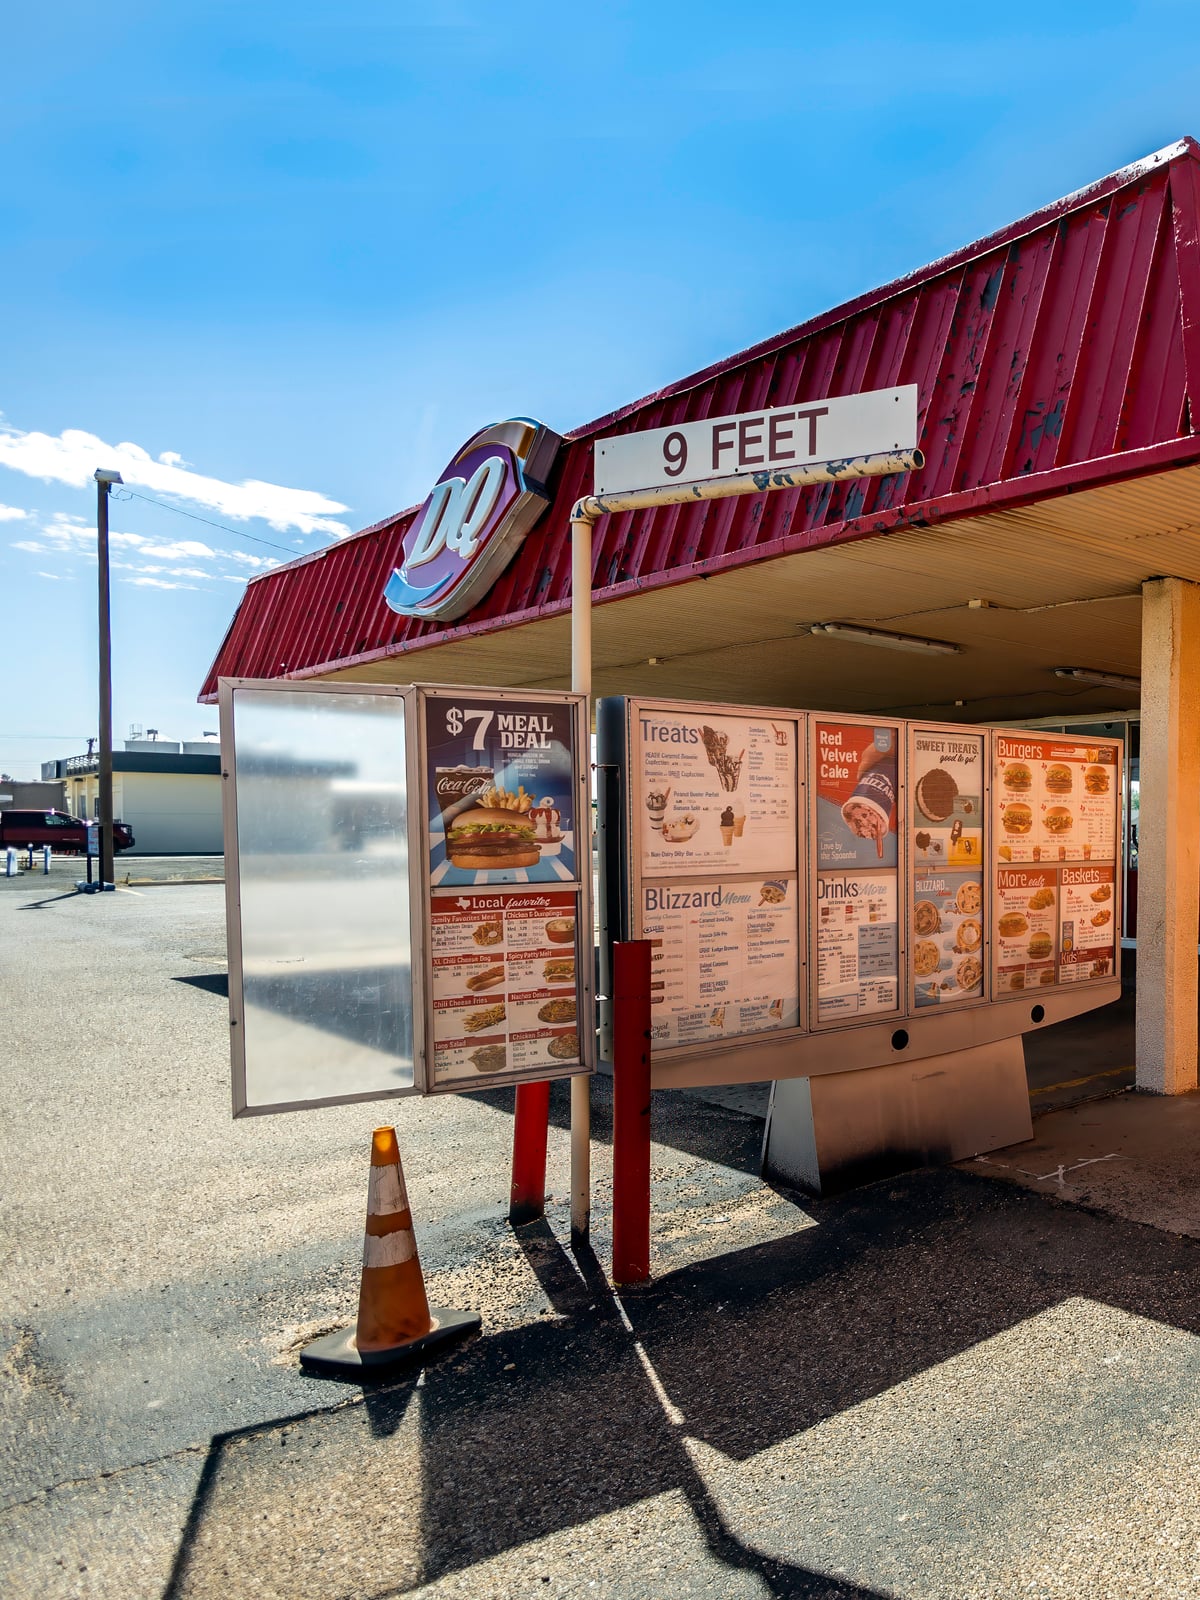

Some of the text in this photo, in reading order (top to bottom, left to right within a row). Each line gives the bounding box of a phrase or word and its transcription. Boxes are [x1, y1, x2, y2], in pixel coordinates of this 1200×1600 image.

[662, 407, 829, 477] 9 FEET
[406, 455, 506, 569] DQ
[446, 707, 494, 750] $7
[497, 714, 553, 733] MEAL
[640, 719, 699, 744] Treats
[820, 731, 842, 745] Red
[500, 732, 551, 749] DEAL
[916, 740, 945, 753] SWEET
[821, 748, 858, 763] Velvet
[998, 739, 1043, 762] Burgers
[940, 754, 957, 764] good
[821, 764, 849, 779] Cake
[998, 871, 1045, 888] More eats
[1062, 868, 1099, 884] Baskets
[818, 877, 858, 899] Drinks
[916, 879, 945, 892] BLIZZARD
[473, 896, 551, 911] Local favorites
[645, 885, 751, 911] Blizzard Menu
[507, 911, 528, 919] Chicken
[434, 1000, 448, 1008] Chili
[449, 999, 471, 1007] Cheese
[652, 1021, 669, 1033] oyal
[450, 1040, 466, 1048] Salad
